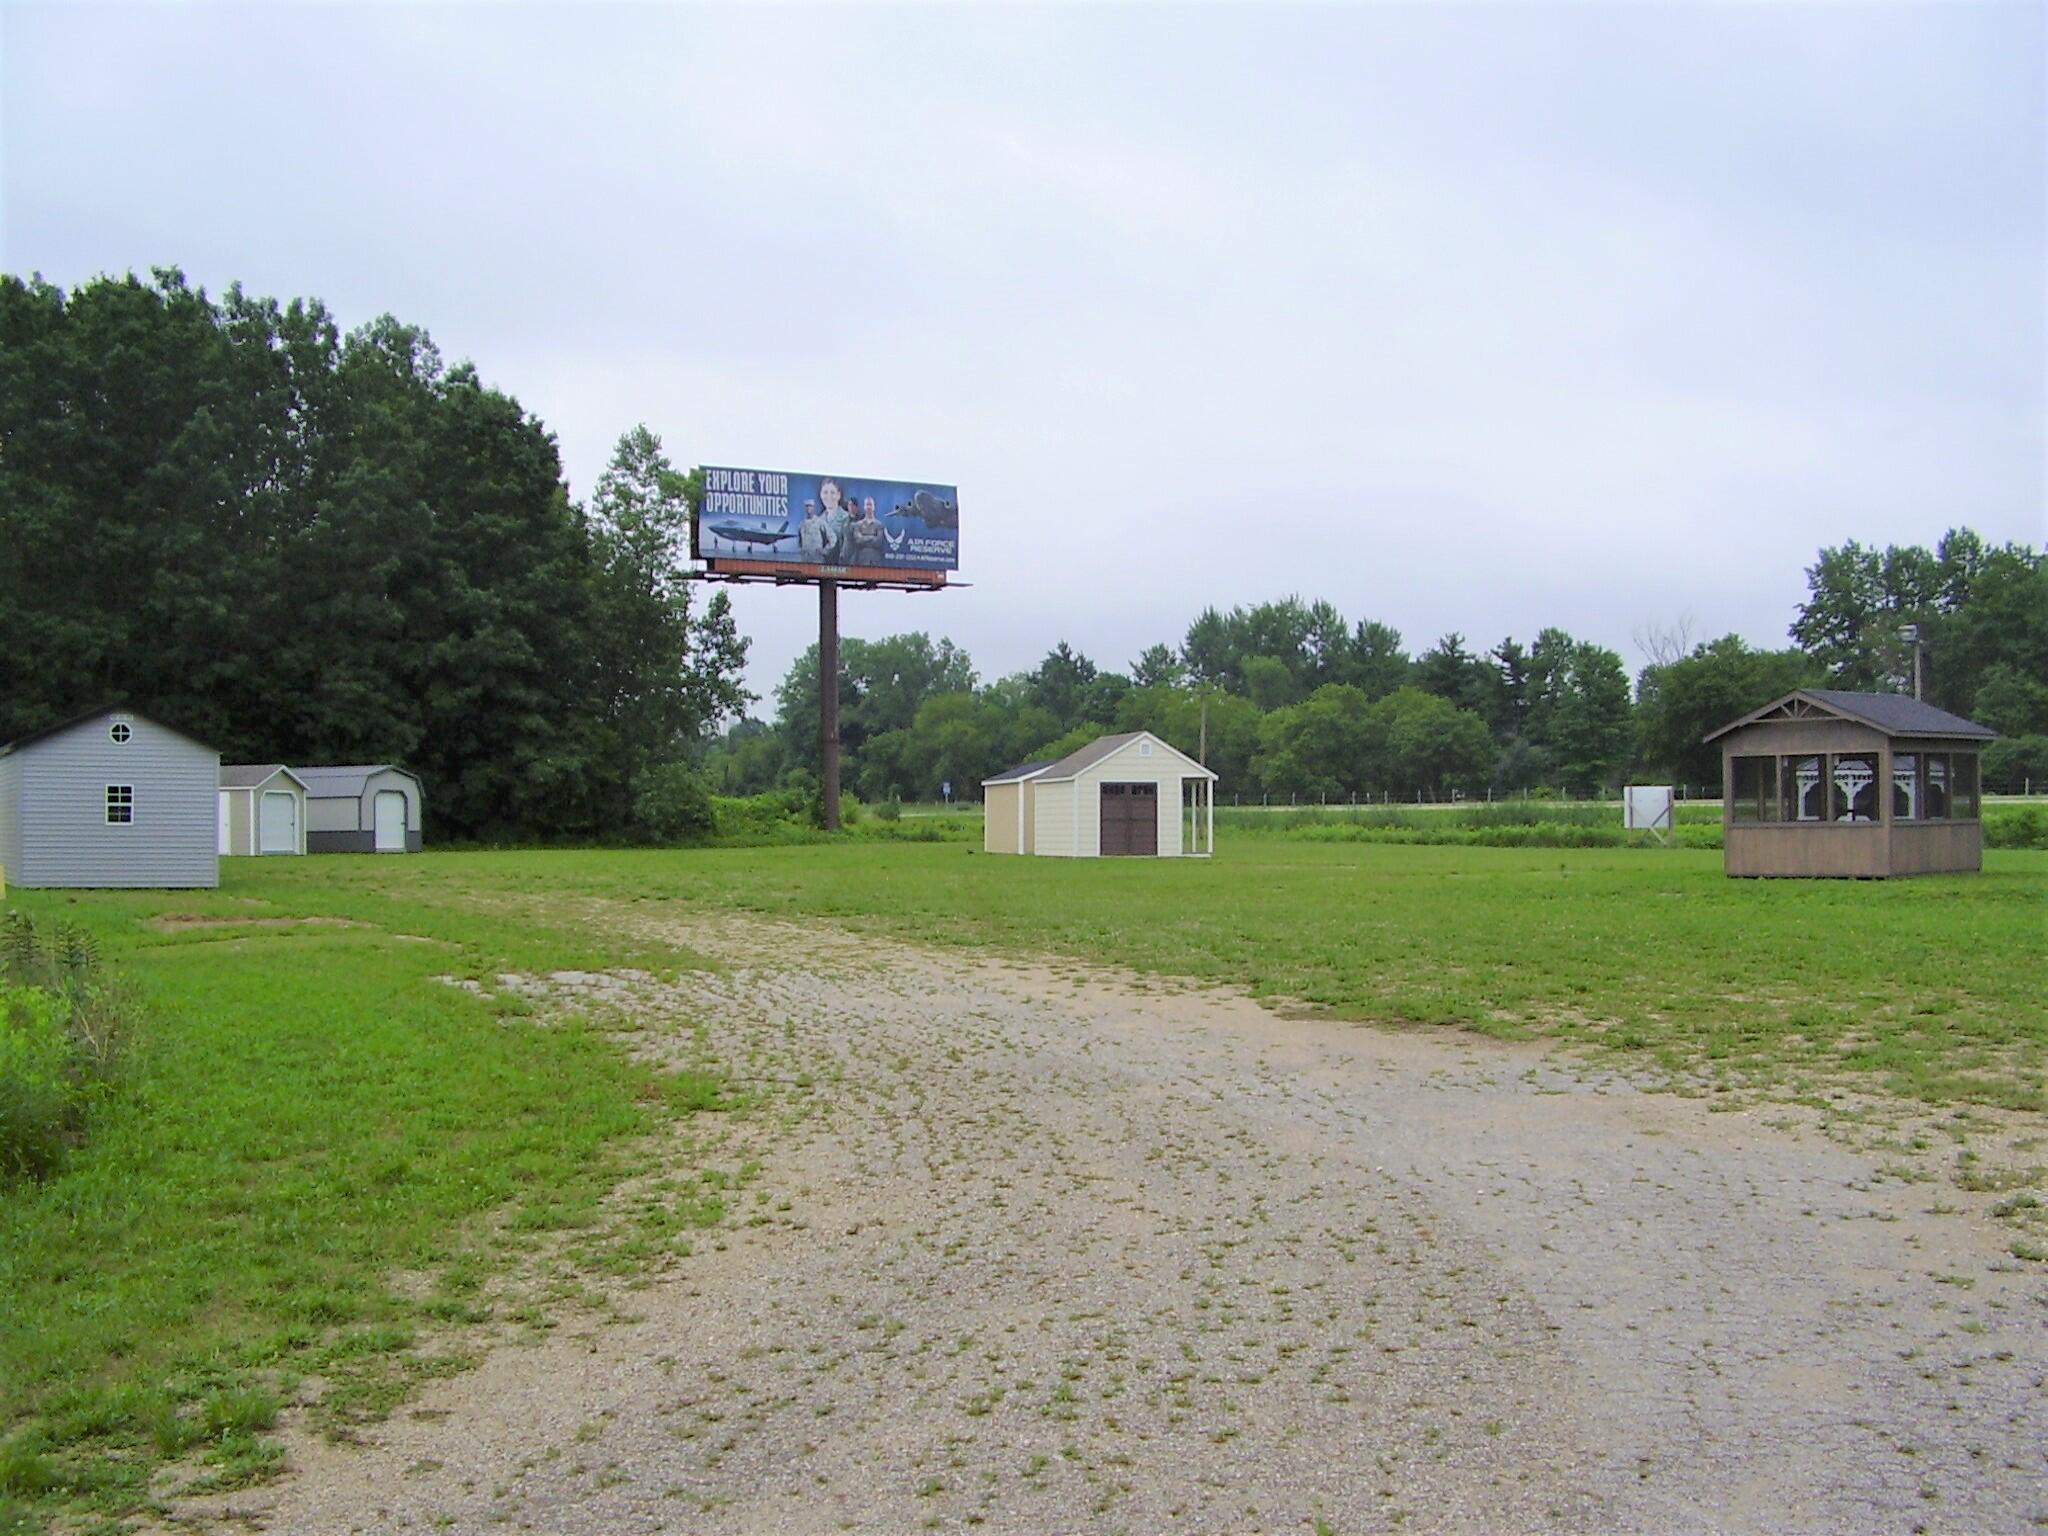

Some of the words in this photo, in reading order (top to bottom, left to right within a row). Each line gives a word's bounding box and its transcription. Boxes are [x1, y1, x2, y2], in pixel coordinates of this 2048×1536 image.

[705, 469, 755, 493] EXPLORE
[758, 472, 788, 495] YOUR
[706, 492, 788, 517] OPPORTUNITIES
[907, 538, 924, 546] AIR
[925, 539, 954, 547] FORCE
[910, 545, 953, 554] RESERVE
